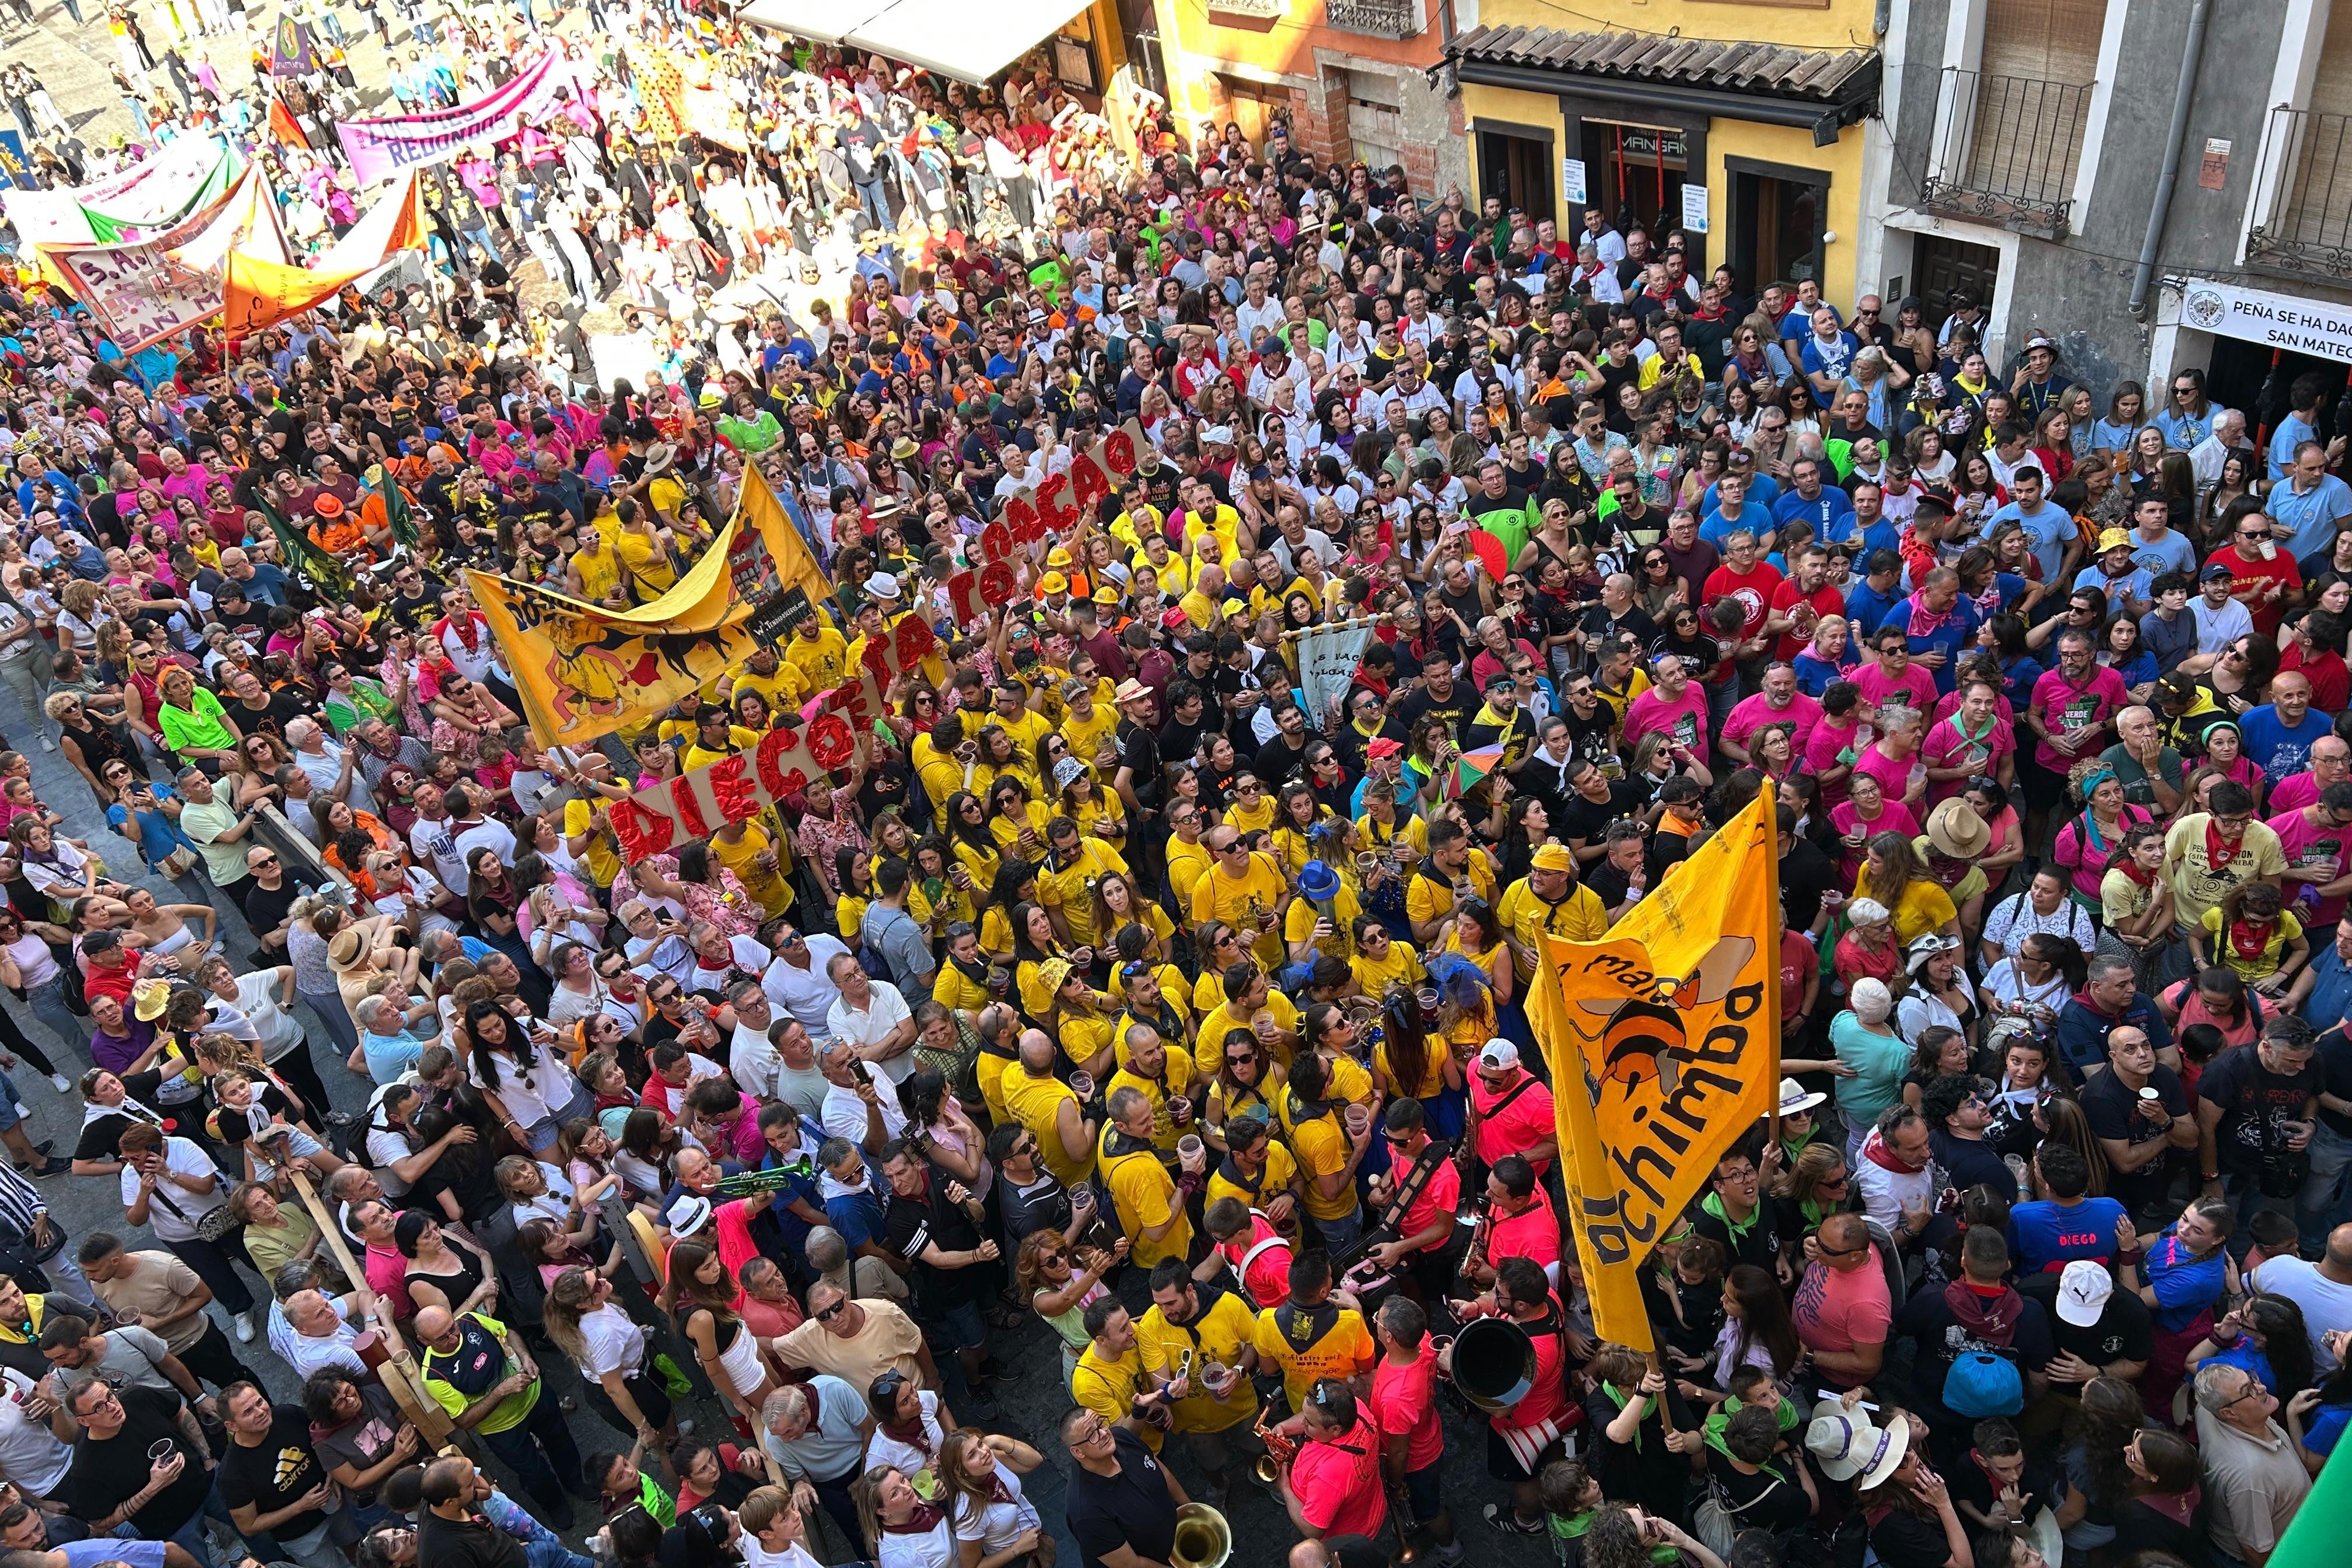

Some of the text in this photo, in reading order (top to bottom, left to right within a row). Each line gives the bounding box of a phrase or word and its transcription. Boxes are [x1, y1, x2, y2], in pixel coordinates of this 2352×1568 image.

[366, 118, 410, 146] LOS
[386, 109, 509, 168] REDONDOS
[1933, 218, 1940, 230] 2
[2233, 300, 2352, 337] PEÑA SE HA DA
[114, 309, 181, 349] SAN
[2267, 330, 2300, 346] SAN
[465, 653, 482, 663] agua
[2066, 702, 2084, 710] VACA
[2065, 710, 2088, 718] VERDE
[1674, 726, 1694, 737] VERDE
[2302, 846, 2321, 855] VACA
[2194, 896, 2211, 905] MATEO
[2059, 1233, 2097, 1246] DIEGO
[278, 1457, 312, 1492] abirras
